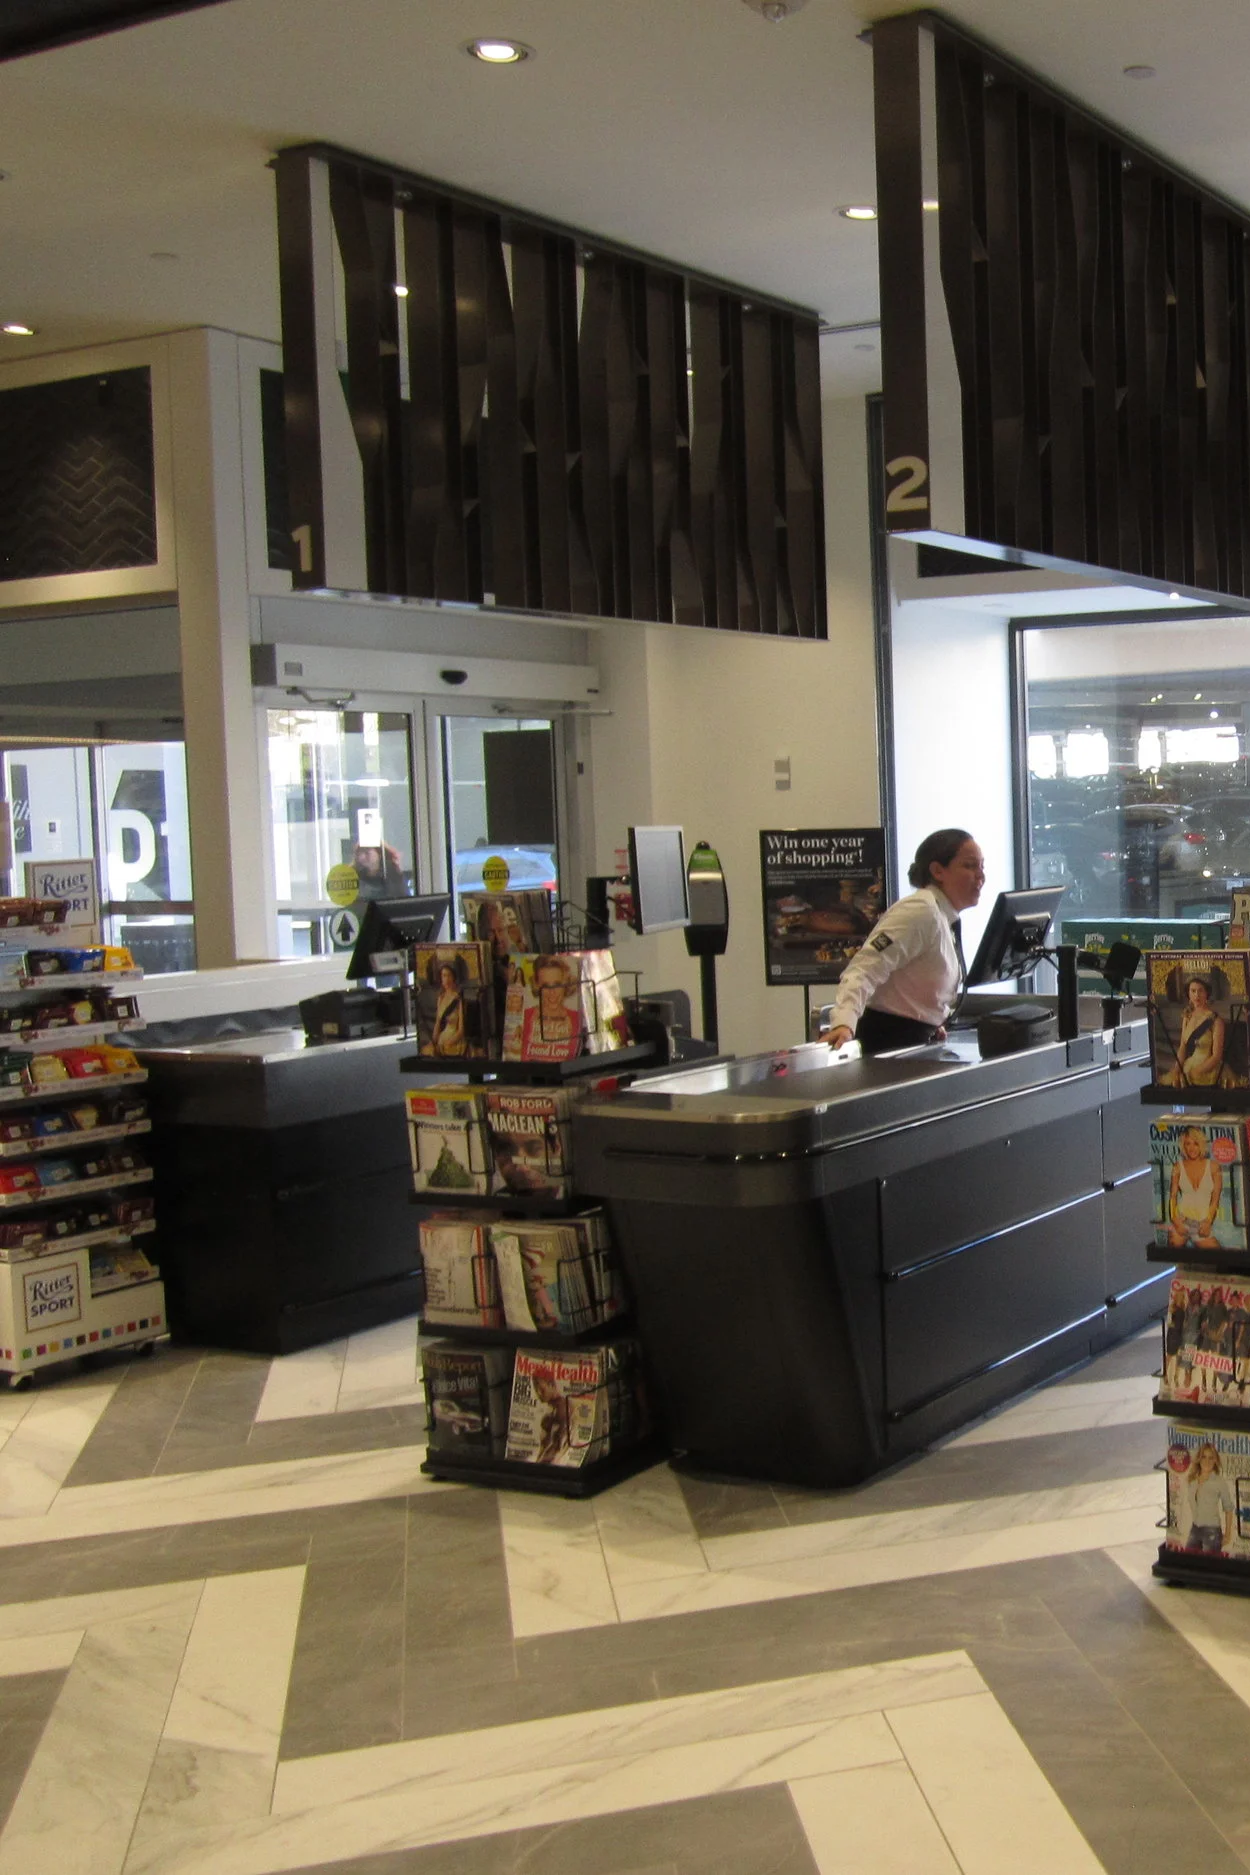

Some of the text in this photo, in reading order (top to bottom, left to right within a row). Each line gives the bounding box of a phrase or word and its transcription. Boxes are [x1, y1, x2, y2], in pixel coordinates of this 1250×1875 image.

[886, 456, 928, 512] 2
[291, 525, 313, 572] 1
[766, 835, 864, 851] Win one year
[767, 850, 784, 865] of
[40, 873, 88, 898] Ritter
[65, 899, 88, 911] ORT
[500, 1098, 552, 1110] ROB FORD
[488, 1113, 558, 1134] MACLEANS
[30, 1273, 74, 1300] Ritter
[31, 1296, 75, 1317] SPORT
[554, 1360, 599, 1383] Health
[515, 1383, 531, 1397] BIG
